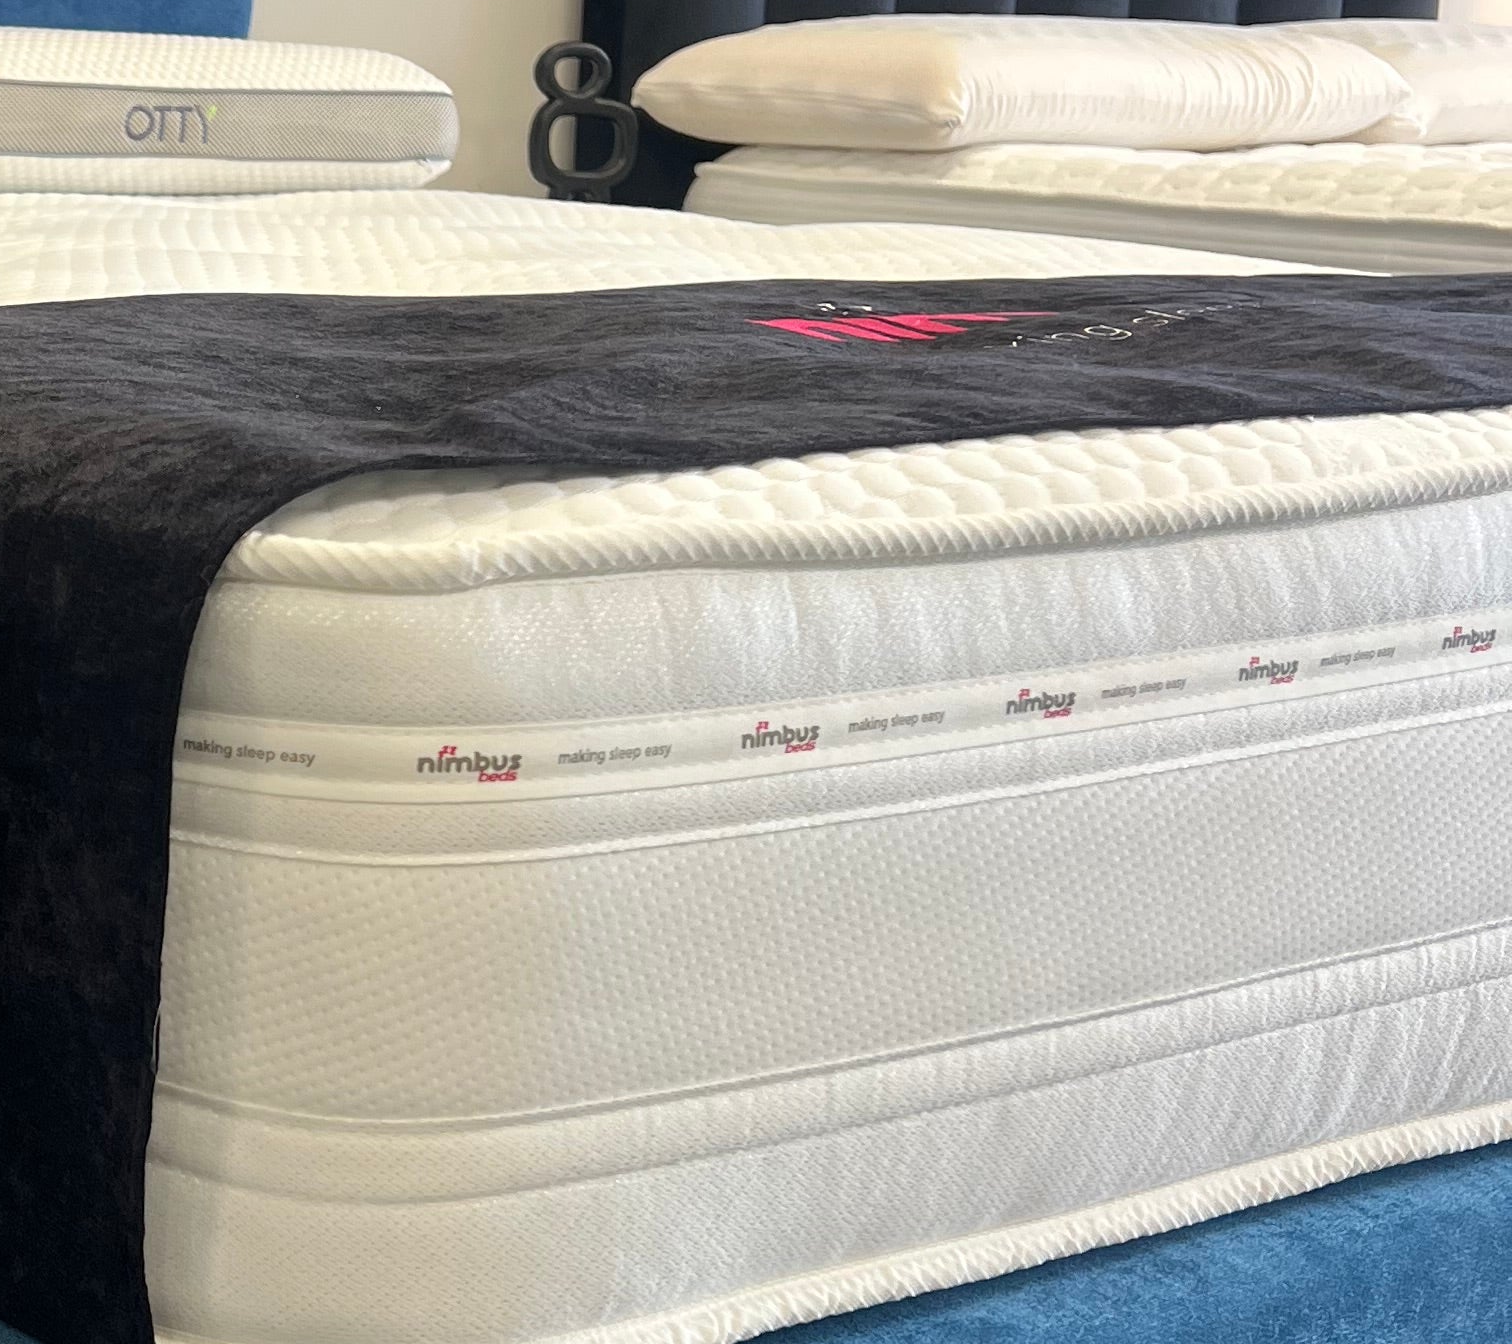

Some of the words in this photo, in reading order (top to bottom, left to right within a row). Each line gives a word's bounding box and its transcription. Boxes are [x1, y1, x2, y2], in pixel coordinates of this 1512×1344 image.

[1441, 628, 1498, 651] nimbus
[1238, 658, 1300, 682] nimbus
[1005, 690, 1077, 715] nimbus
[740, 723, 821, 750] nimbus
[848, 717, 889, 733] making
[183, 739, 233, 759] making
[236, 744, 276, 763] sleep
[279, 751, 316, 768] easy
[557, 748, 607, 766] making
[608, 745, 643, 762] sleep
[644, 742, 673, 759] easy
[784, 740, 817, 754] beds
[417, 748, 523, 774] nimbus
[477, 768, 518, 783] beds
